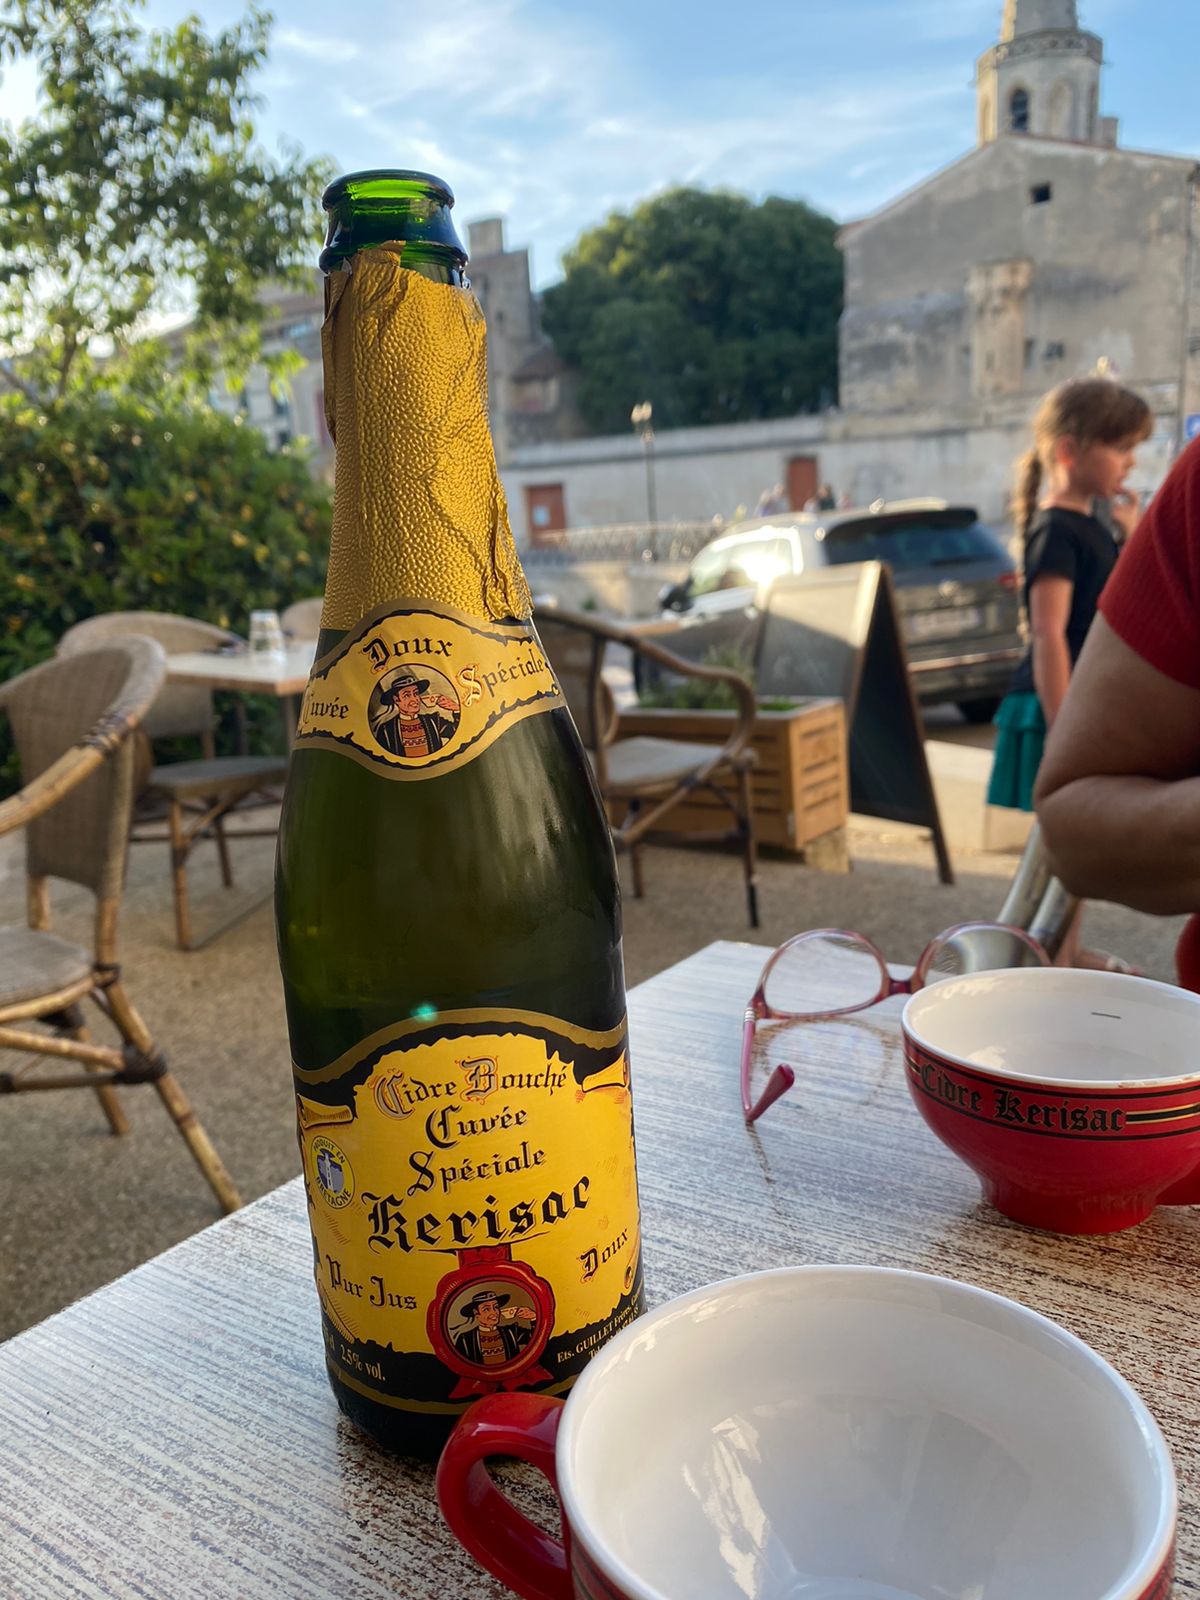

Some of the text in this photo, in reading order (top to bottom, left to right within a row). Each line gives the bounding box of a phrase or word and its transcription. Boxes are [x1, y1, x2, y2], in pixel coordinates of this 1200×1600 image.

[361, 635, 453, 674] Doux
[456, 648, 544, 707] Spéciale
[372, 1056, 569, 1119] Cidre Bouché
[920, 1064, 1126, 1132] Cidre Kerisac
[425, 1104, 528, 1149] Cuvée
[406, 1141, 546, 1197] Spéciale
[361, 1176, 592, 1254] Kerisac
[325, 1254, 418, 1310] Pur Jus
[578, 1228, 629, 1281] Doux
[556, 1350, 575, 1363] Ets.
[575, 1321, 614, 1354] GUILLET
[365, 1362, 386, 1381] vol.
